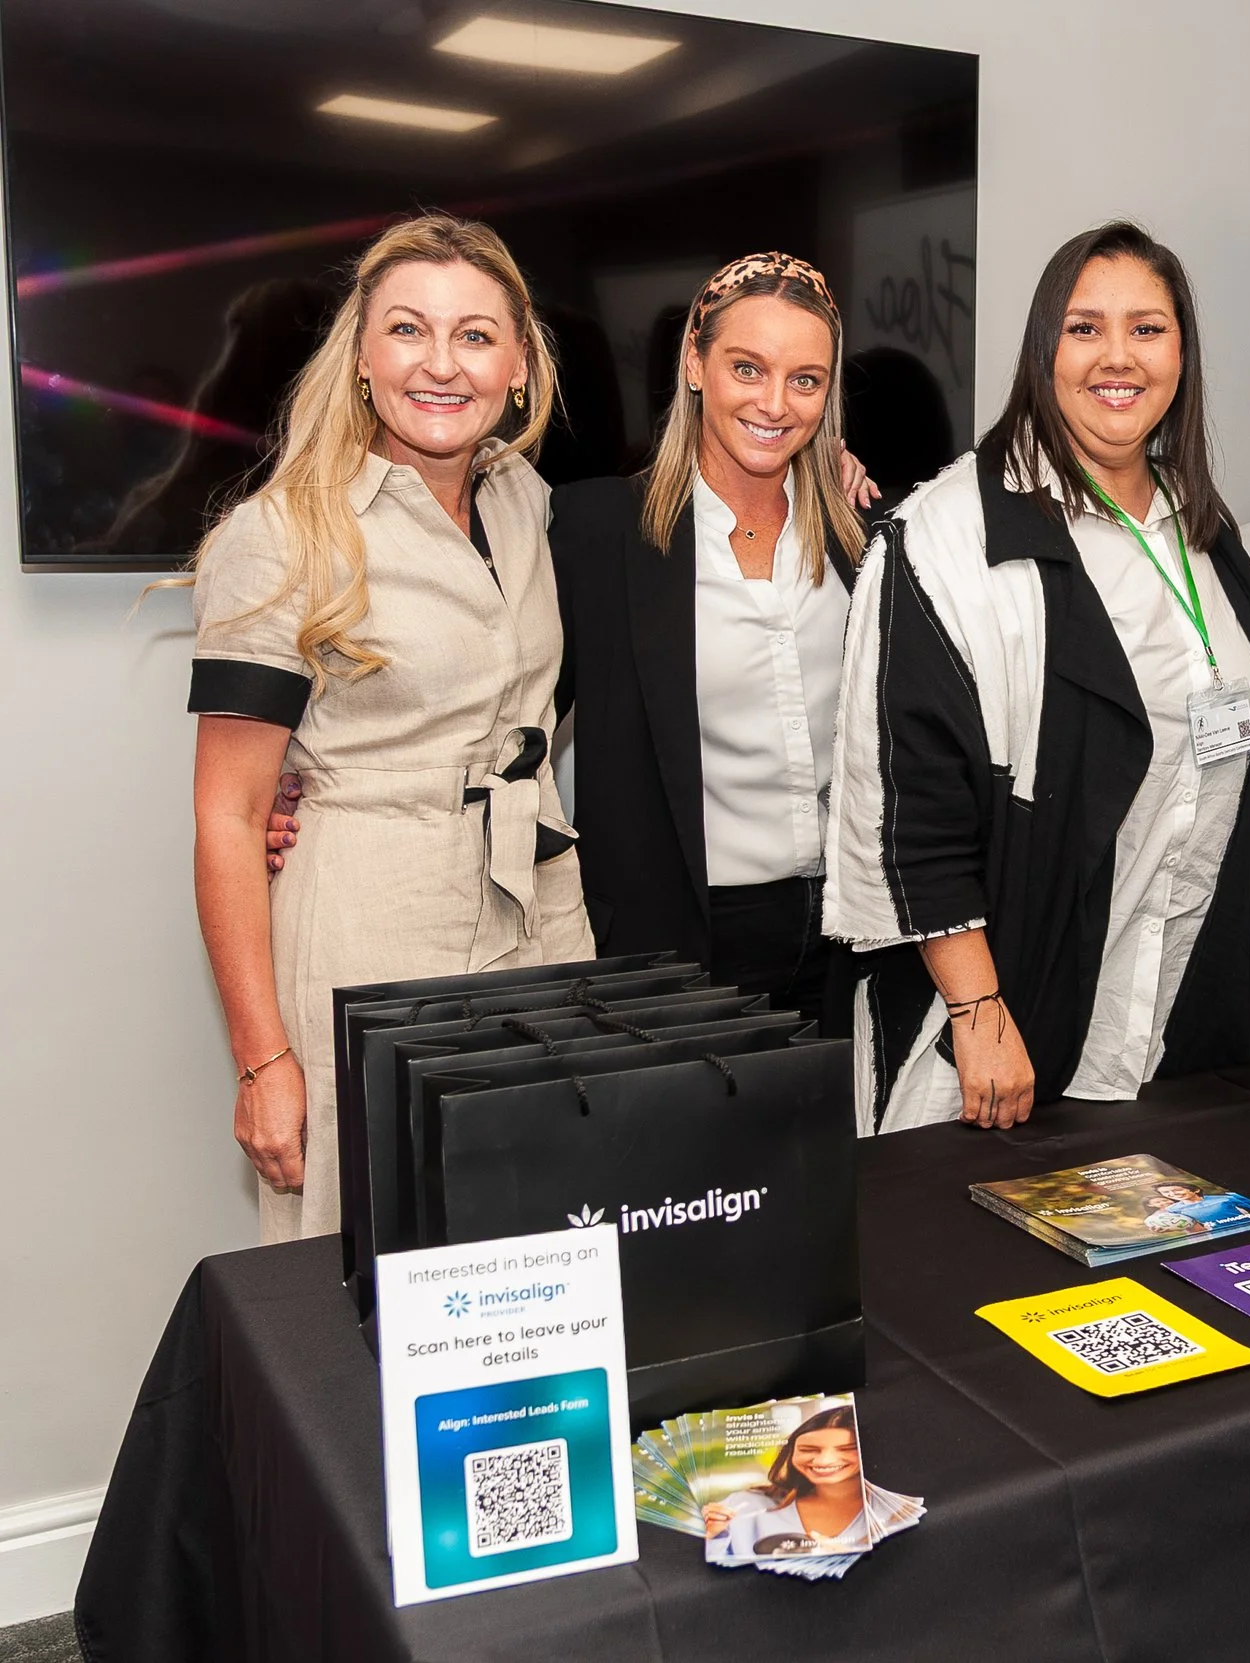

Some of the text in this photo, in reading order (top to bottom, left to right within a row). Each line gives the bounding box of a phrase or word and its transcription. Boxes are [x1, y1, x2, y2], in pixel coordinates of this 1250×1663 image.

[621, 1188, 762, 1233] invisalign
[408, 1247, 599, 1284] Interested in being an
[479, 1282, 566, 1306] invisalign
[1047, 1295, 1122, 1315] invisalign
[407, 1316, 608, 1357] Scan here to leave your
[483, 1347, 539, 1366] details
[438, 1398, 589, 1432] Align: Interested Leads Form
